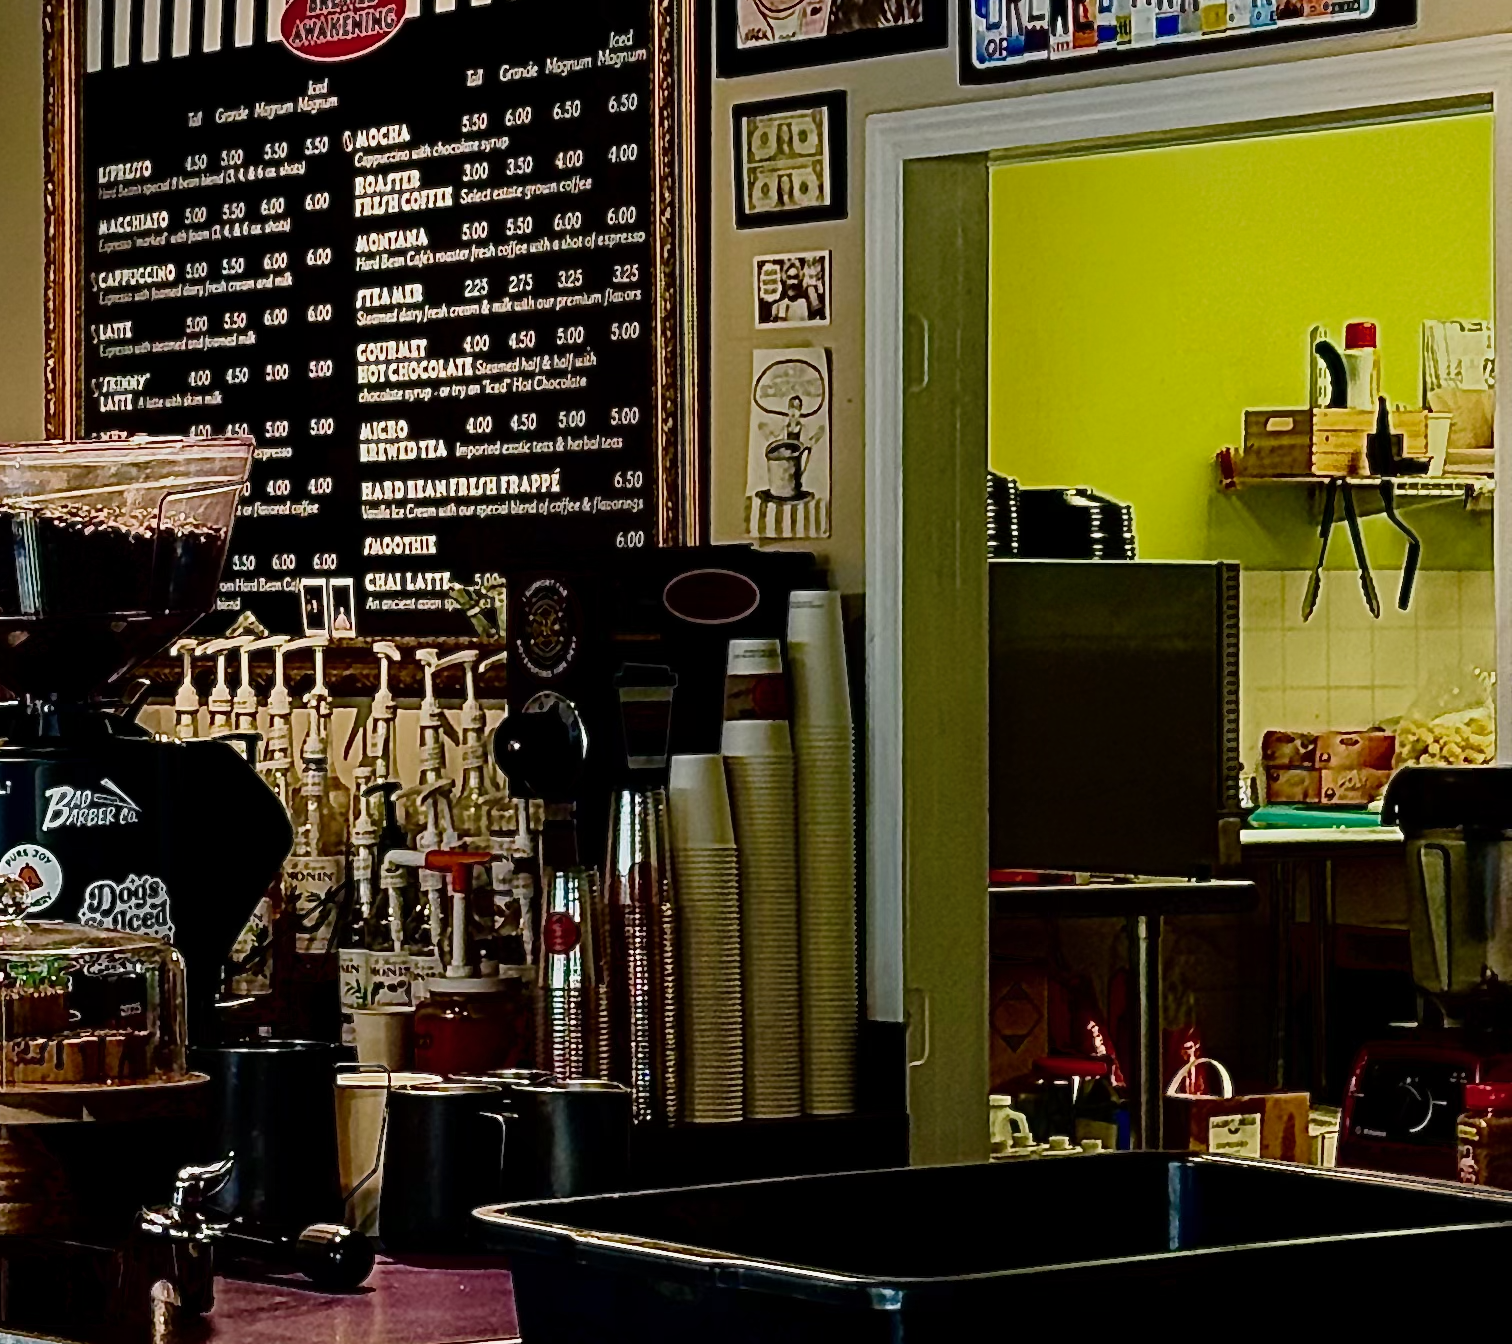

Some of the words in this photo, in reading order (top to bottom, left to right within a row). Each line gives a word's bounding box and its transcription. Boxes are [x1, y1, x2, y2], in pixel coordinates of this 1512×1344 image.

[289, 4, 396, 47] AWAKENING
[609, 29, 633, 48] Iced
[500, 62, 538, 82] Grande
[546, 56, 592, 76] Magnum
[598, 47, 646, 69] Magnum
[356, 124, 410, 148] MOCHA
[462, 113, 487, 132] 5.50
[505, 107, 532, 127] 6.00
[554, 100, 580, 120] 6.50
[609, 94, 637, 113] 6.50
[355, 170, 420, 195] ROASTER
[556, 150, 582, 169] 4.00
[608, 144, 637, 163] 4.00
[355, 192, 399, 217] FRESH
[401, 187, 452, 211] COFFEE
[461, 188, 490, 204] Select
[560, 176, 592, 193] coffee
[98, 211, 168, 235] MACCHIATO
[306, 193, 329, 210] 6.00
[356, 228, 428, 252] MONTANA
[462, 222, 488, 240] 5.00
[506, 216, 532, 235] 5.50
[554, 212, 581, 230] 6.00
[608, 206, 636, 224] 6.00
[598, 232, 645, 248] espresso
[99, 264, 175, 288] CAPPUCCINO
[264, 252, 287, 270] 6.00
[307, 248, 331, 265] 6.00
[356, 284, 423, 308] STEAMER
[99, 321, 132, 341] LATTE
[224, 313, 246, 329] 5.50
[264, 309, 287, 325] 6.00
[308, 304, 332, 321] 6.00
[357, 340, 427, 362] GOURMET
[557, 326, 584, 344] 5.00
[611, 322, 639, 340] 5.00
[309, 360, 332, 377] 5.00
[358, 364, 386, 384] HOT
[388, 357, 473, 382] CHOCOLATE
[534, 374, 586, 390] Chocolate
[360, 420, 408, 440] MICRO
[558, 410, 586, 428] 5.00
[611, 407, 638, 426] 5.00
[360, 442, 418, 462] BREWED
[421, 440, 447, 458] TEA
[456, 442, 500, 458] Imported
[362, 481, 404, 501] HARD
[407, 479, 446, 499] BEAN
[450, 476, 497, 497] FRESH
[501, 468, 560, 494] FRAPPÉ
[614, 471, 642, 489] 6.50
[364, 535, 436, 556] SMOOTHIE
[616, 531, 644, 548] 6.00
[365, 572, 401, 591] CHAI
[406, 572, 450, 590] LATTE
[33, 849, 53, 865] JOY
[87, 878, 161, 919] Dogs
